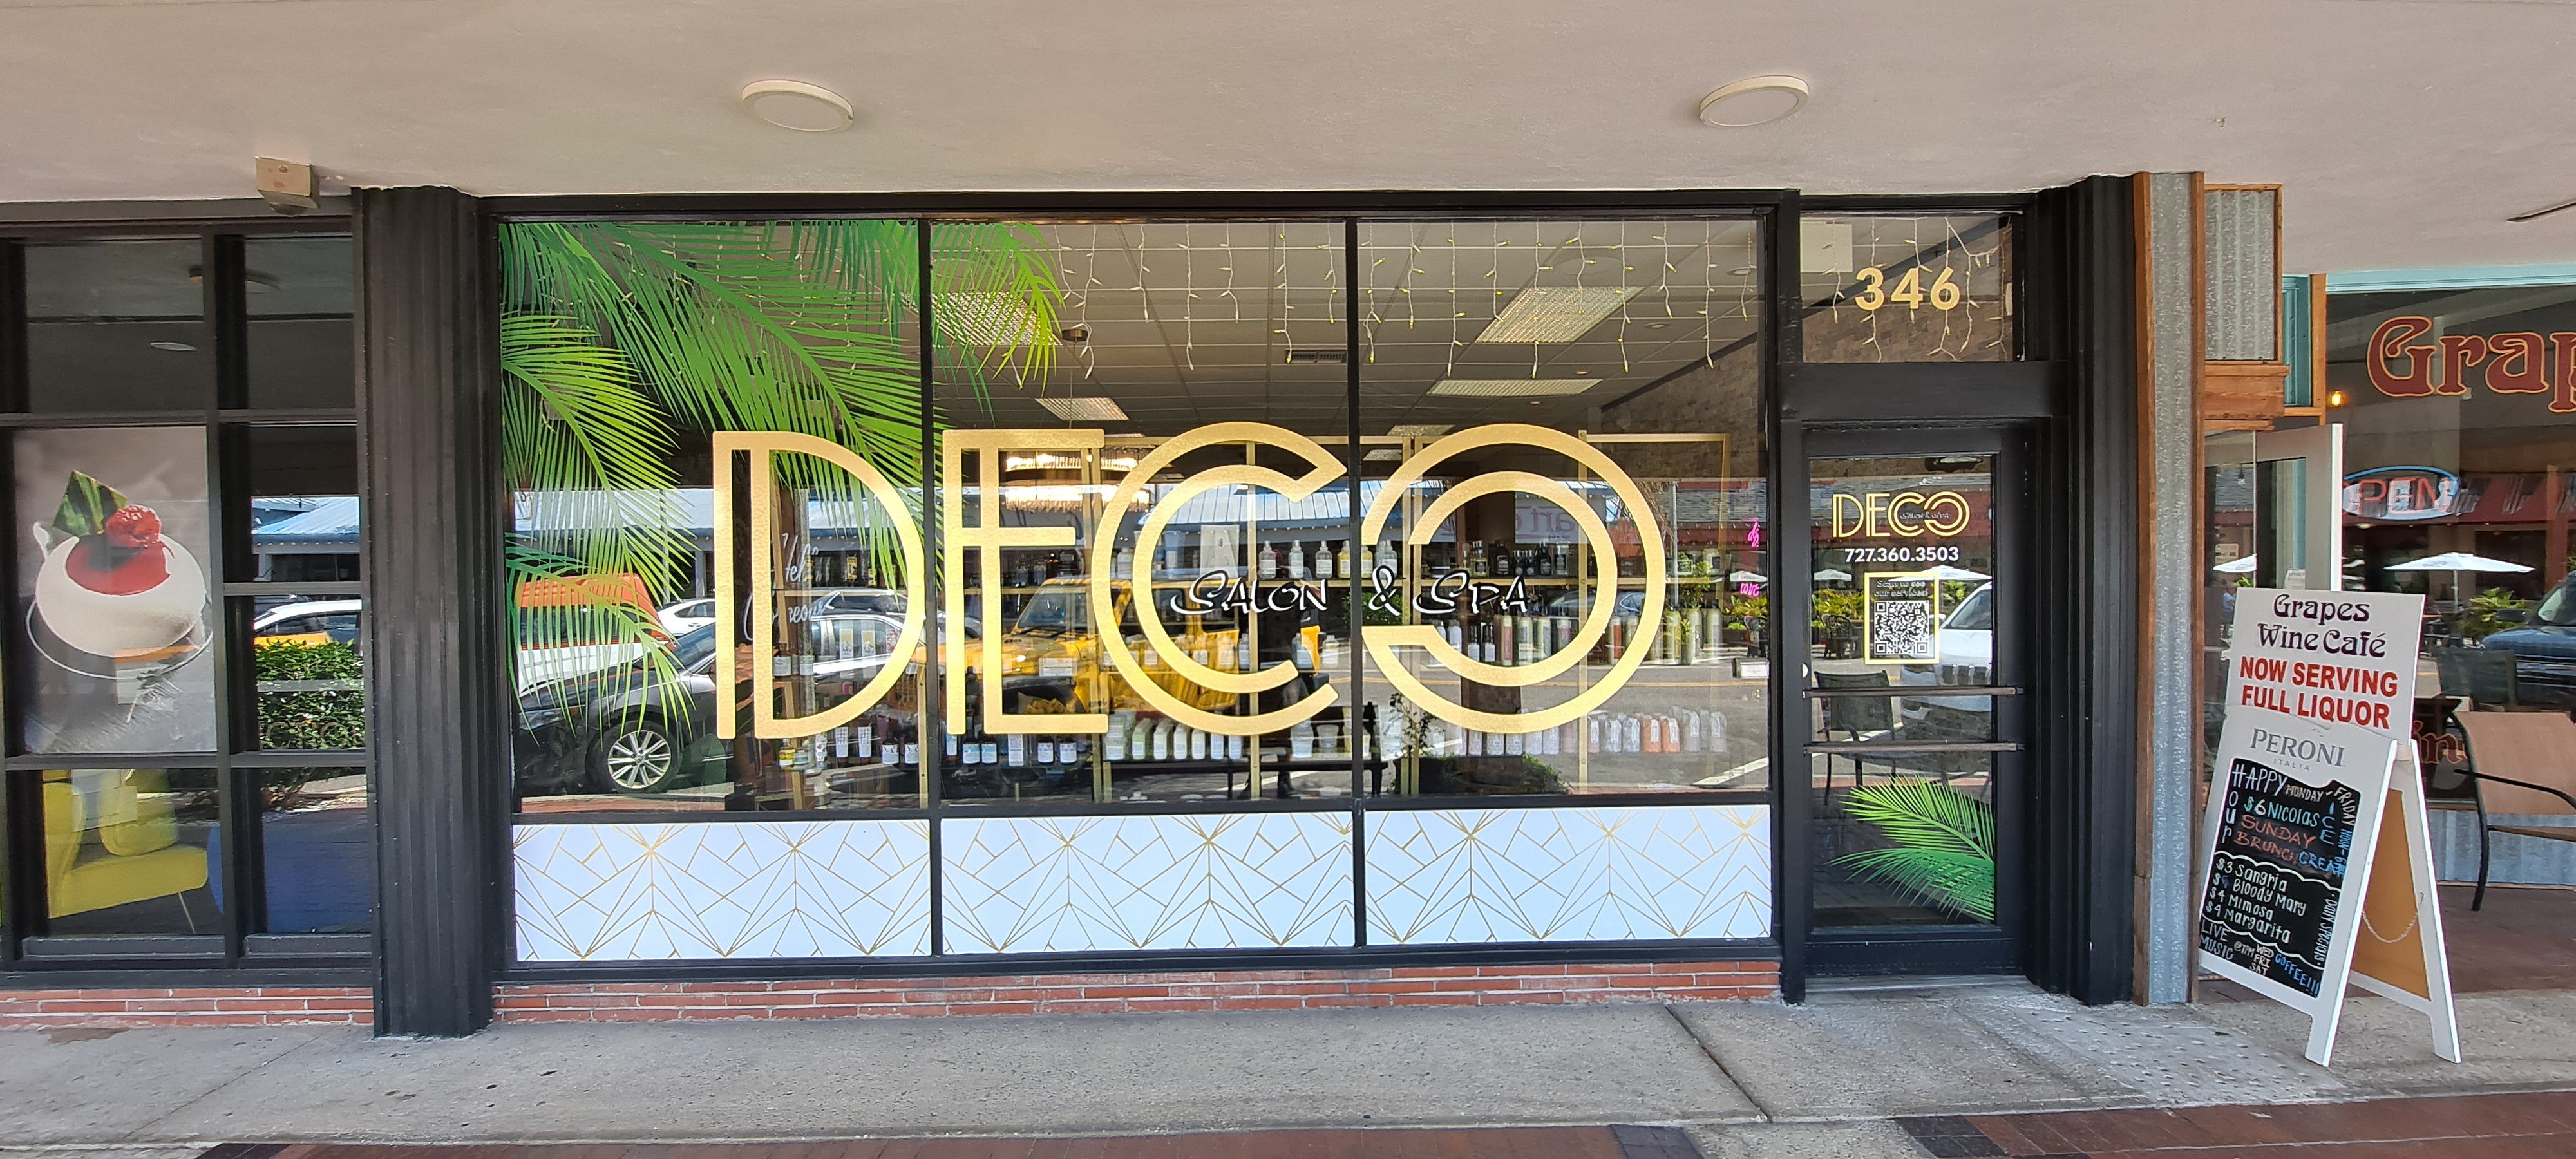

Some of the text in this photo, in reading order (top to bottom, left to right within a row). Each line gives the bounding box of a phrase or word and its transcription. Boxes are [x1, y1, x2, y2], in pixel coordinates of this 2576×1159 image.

[1855, 267, 1960, 311] 346
[2343, 477, 2450, 515] PEN
[1832, 491, 1971, 538] DECO
[1844, 547, 1959, 563] 727.360.3503
[714, 422, 1667, 740] DECO
[1367, 564, 1402, 617] &
[2274, 594, 2371, 625] Grapes
[2257, 623, 2387, 658] Wine Café
[2240, 656, 2399, 697] NOW SERVING
[2241, 684, 2390, 730] FULL LIQUOR
[2250, 728, 2345, 768] PERONI
[2273, 758, 2311, 771] ITALIA
[2231, 764, 2288, 796] HAPPY
[2286, 784, 2324, 802] MONDAY
[2241, 813, 2316, 849] SUNDAY
[2215, 858, 2287, 892] $3 Sangria
[2209, 887, 2226, 903] $4
[2232, 878, 2273, 903] Bloody
[2275, 892, 2307, 916] Mary
[2201, 919, 2231, 942] LIVE
[2224, 908, 2291, 944] Margarita
[2200, 934, 2234, 960] MUSIC
[2249, 962, 2269, 975] SAT
